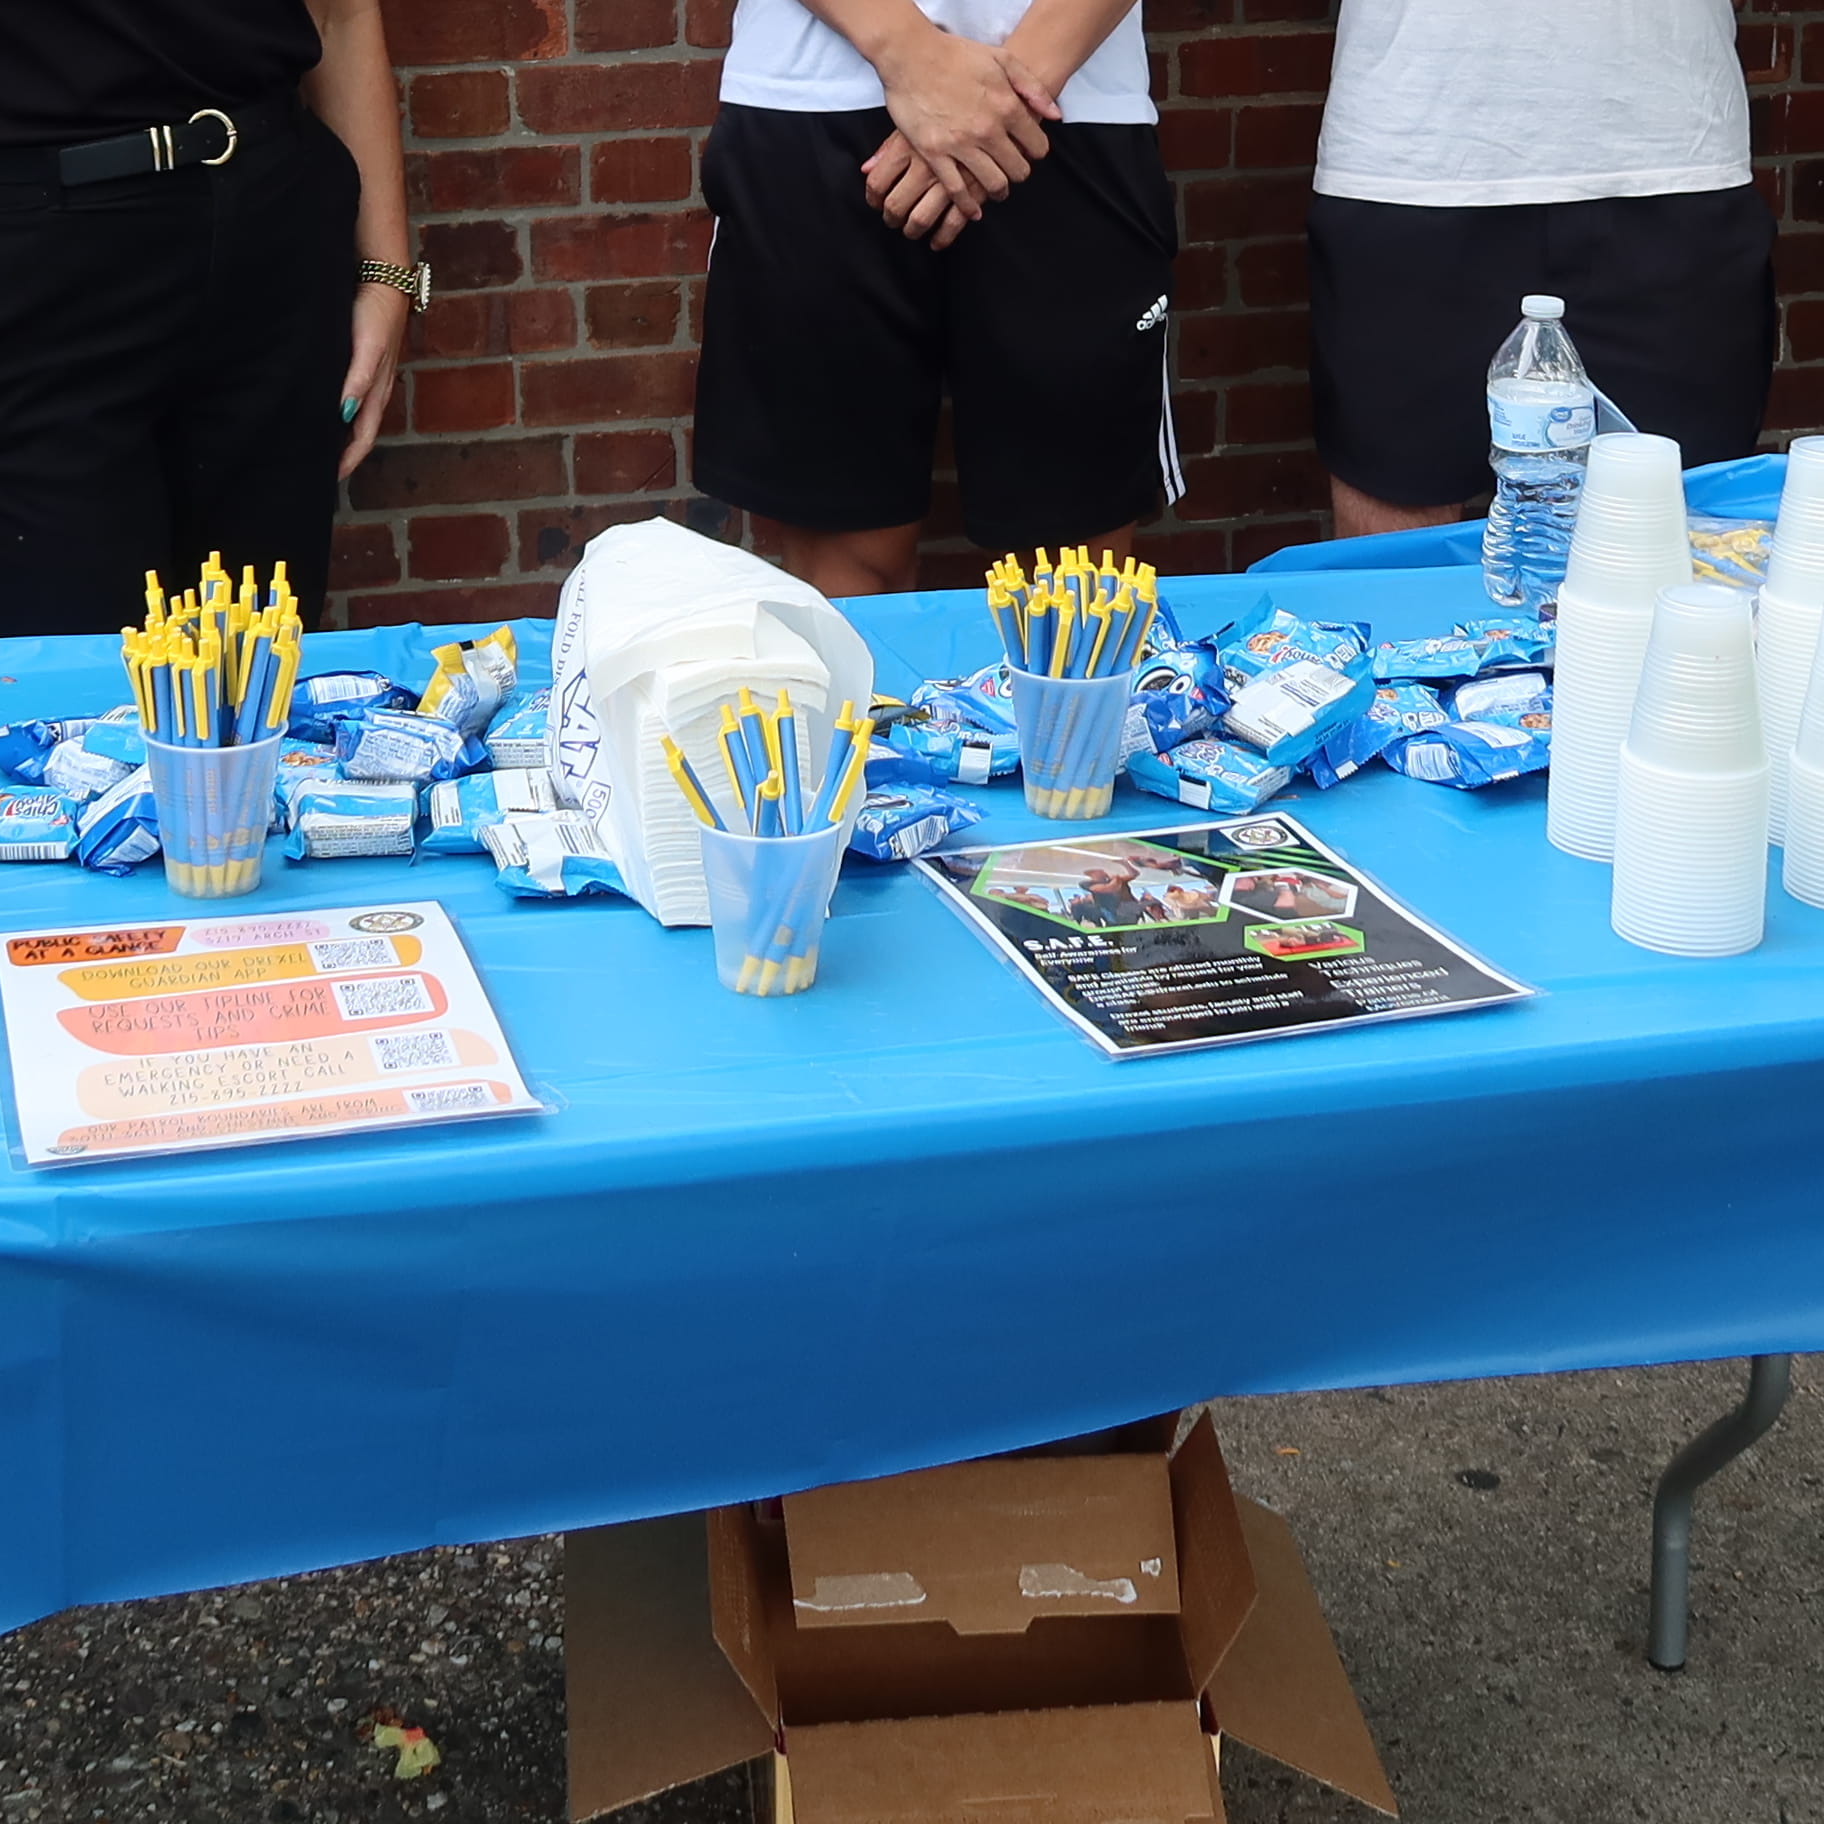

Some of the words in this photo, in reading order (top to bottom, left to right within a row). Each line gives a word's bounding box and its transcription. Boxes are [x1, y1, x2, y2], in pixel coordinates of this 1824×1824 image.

[561, 612, 582, 654] FOLD
[12, 936, 80, 950] PUBLIC
[93, 930, 166, 943] SAFETY
[25, 948, 47, 960] AT
[61, 946, 75, 957] A
[86, 941, 165, 955] GLANCE
[81, 963, 183, 981] DOWNLOAD
[195, 957, 231, 972] OUR
[243, 953, 307, 968] DREXEL
[1308, 955, 1376, 970] Various
[1319, 959, 1423, 978] Techniques
[129, 972, 221, 988] GUARDIAN
[234, 967, 267, 980] APP
[1329, 966, 1449, 990] Experienced
[89, 1005, 129, 1018] USE
[145, 999, 186, 1014] OUR
[203, 992, 274, 1010] TIPLINE
[290, 987, 326, 1002] FOR
[92, 1013, 199, 1033] REQUESTS
[215, 1008, 255, 1024] AND
[269, 1001, 330, 1018] CRIME
[196, 1025, 240, 1041] TIPS
[174, 1052, 210, 1066] YOU
[224, 1047, 273, 1061] HAVE
[288, 1043, 313, 1054] AN
[104, 1063, 227, 1086] EMERGENCY
[242, 1058, 264, 1071] OR
[278, 1053, 329, 1068] NEED
[344, 1050, 354, 1062] A
[118, 1078, 206, 1098] WALKING
[218, 1070, 289, 1087] ESCORT
[304, 1063, 347, 1078] CALL
